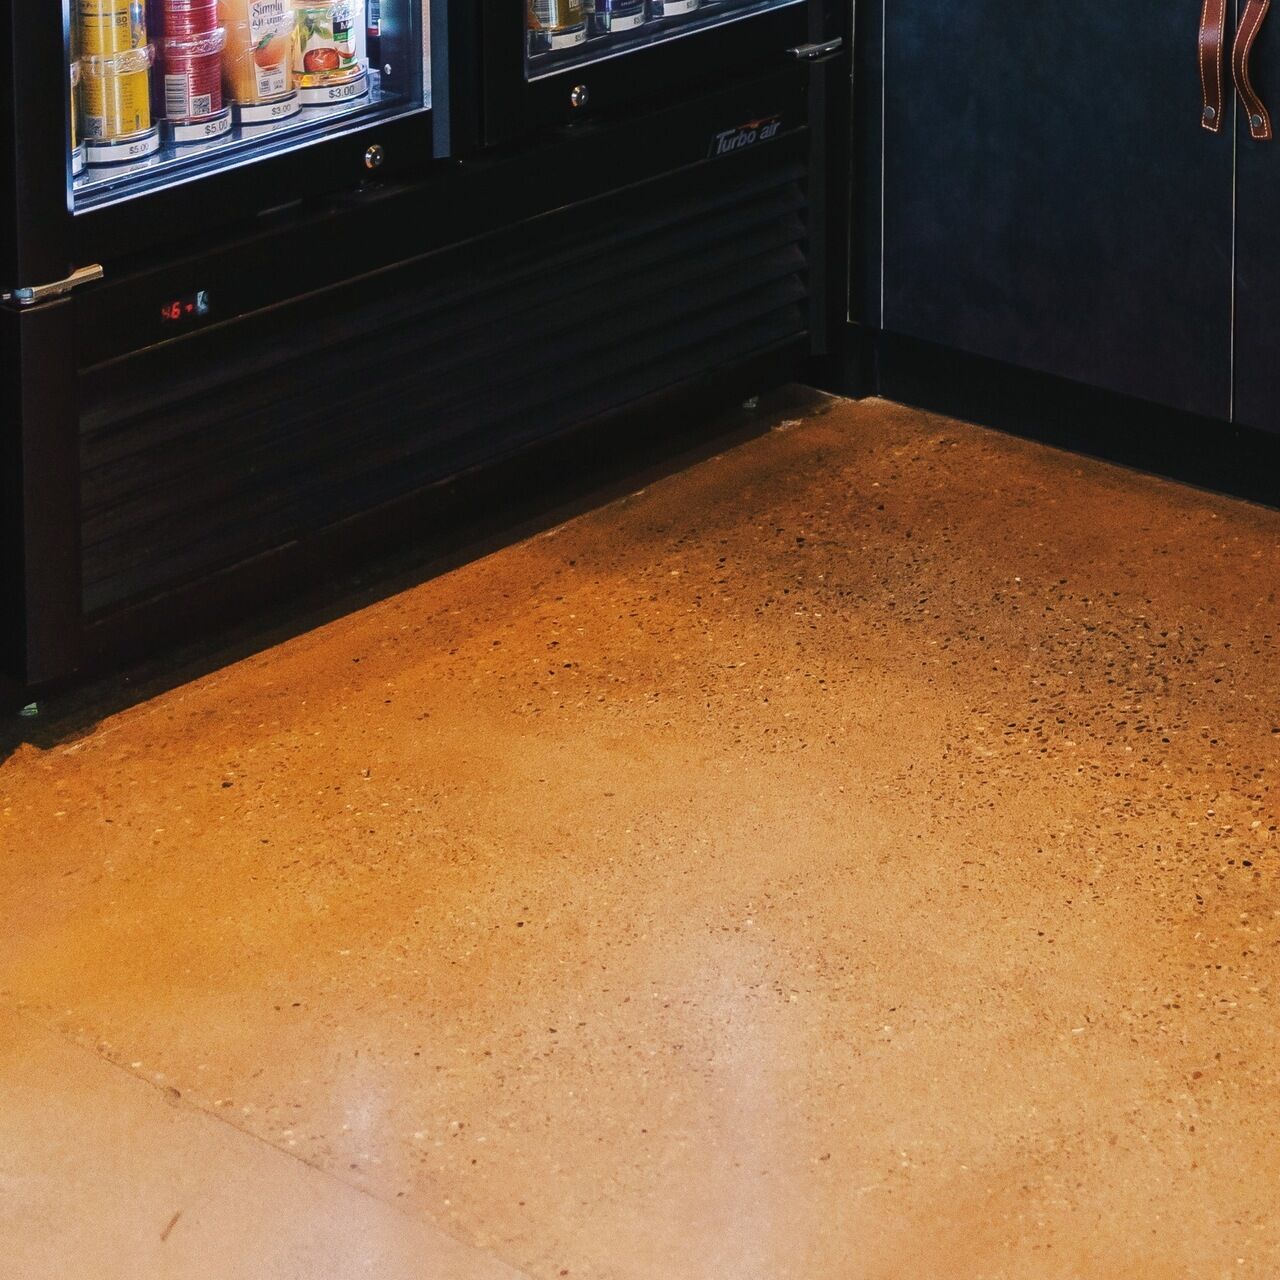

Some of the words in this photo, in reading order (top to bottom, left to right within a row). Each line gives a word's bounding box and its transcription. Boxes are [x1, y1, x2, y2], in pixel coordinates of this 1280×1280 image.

[252, 2, 283, 17] Simply
[328, 85, 355, 98] $3.00
[271, 104, 291, 116] $3.00
[204, 121, 228, 136] $5.00
[716, 129, 756, 155] Turbo
[760, 120, 781, 139] air
[128, 142, 150, 155] $5.00
